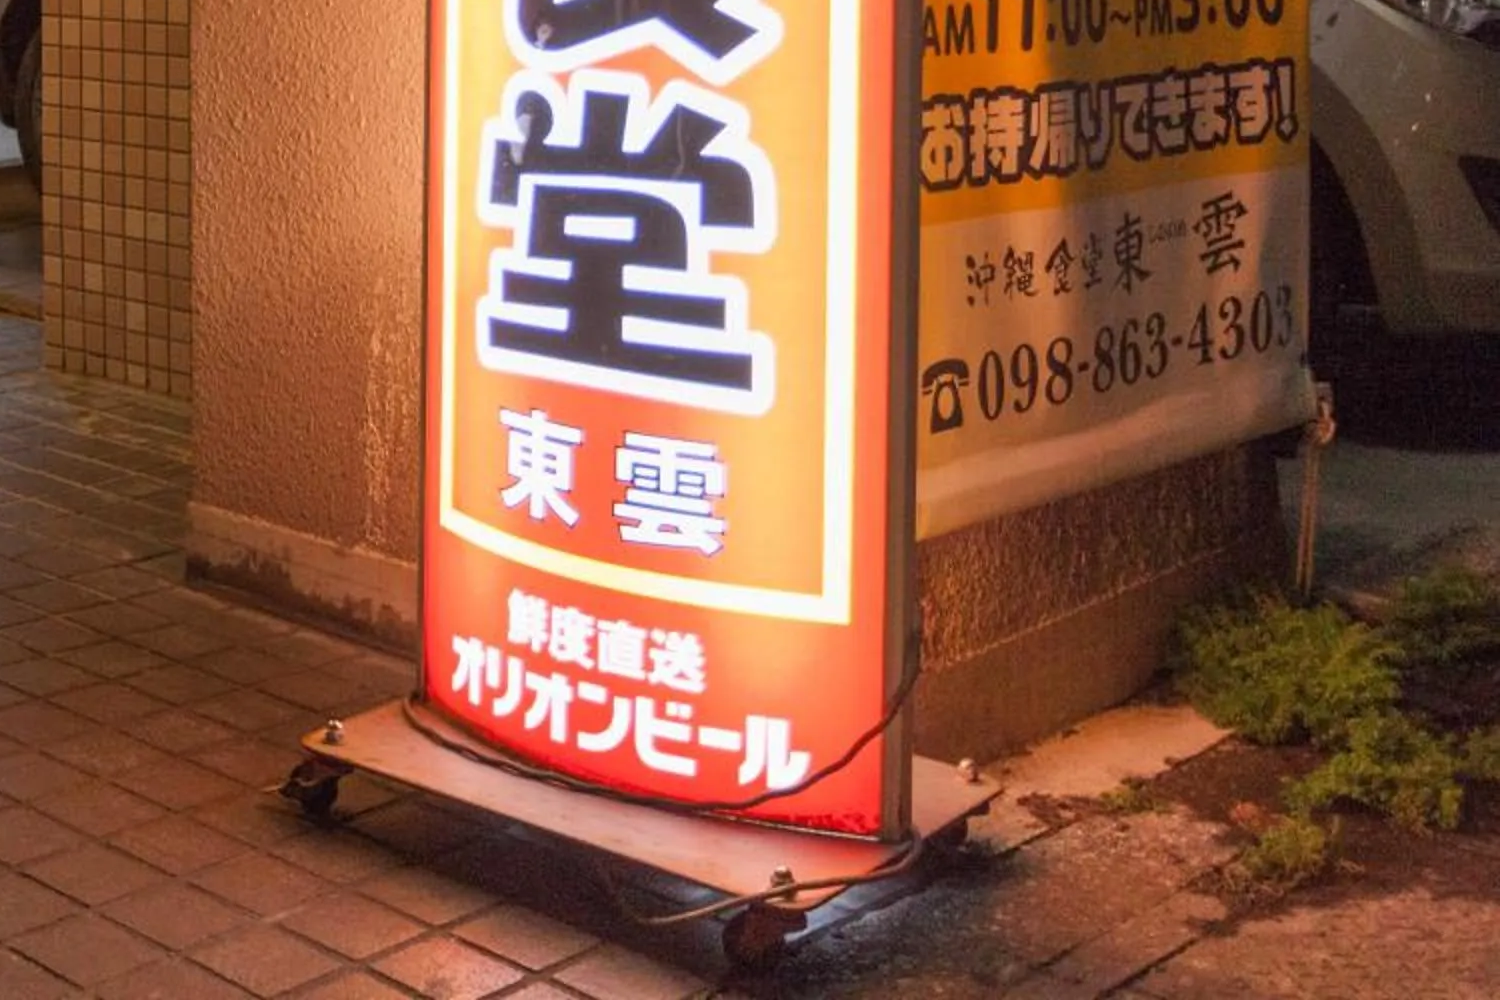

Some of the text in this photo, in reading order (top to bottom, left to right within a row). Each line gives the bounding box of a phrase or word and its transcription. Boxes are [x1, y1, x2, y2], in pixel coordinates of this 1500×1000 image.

[977, 282, 1295, 420] 098-863-4303
[499, 406, 729, 556] 東雲
[452, 634, 810, 789] オリオンビール
[507, 587, 706, 694] 鮮度直送
